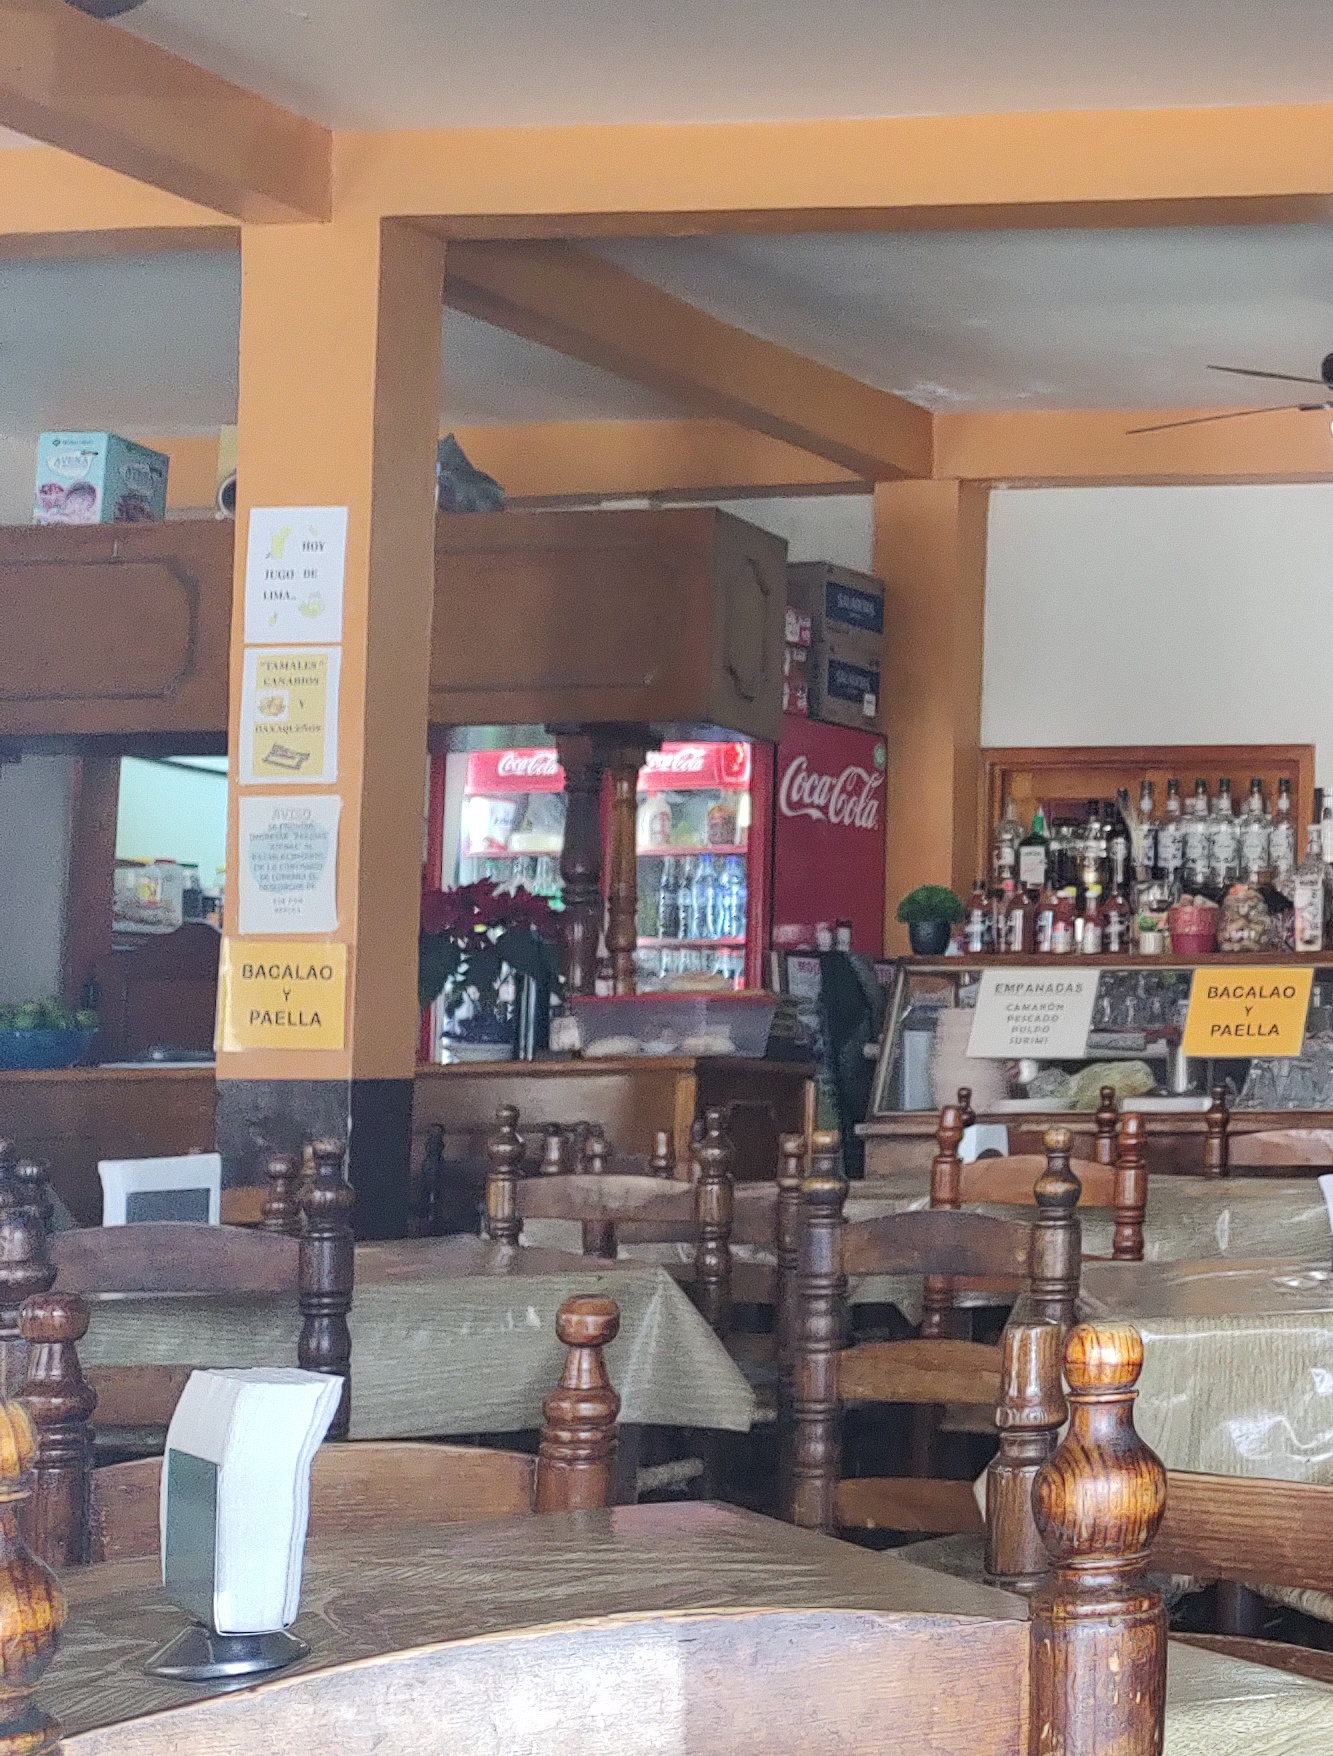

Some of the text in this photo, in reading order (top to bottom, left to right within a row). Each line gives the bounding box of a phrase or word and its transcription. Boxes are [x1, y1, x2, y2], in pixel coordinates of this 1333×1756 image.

[302, 541, 325, 552] HOY
[264, 569, 318, 580] JUGO DE
[242, 964, 333, 980] BACALAO
[994, 982, 1083, 994] EMPANADAS
[1207, 985, 1296, 999] BACALAO
[283, 987, 291, 1002] Y
[1244, 1005, 1253, 1017] Y
[249, 1010, 322, 1027] PAELLA
[1007, 1014, 1059, 1023] PESCADO
[1011, 1025, 1050, 1034] PULPO
[1211, 1023, 1280, 1037] PAELLA
